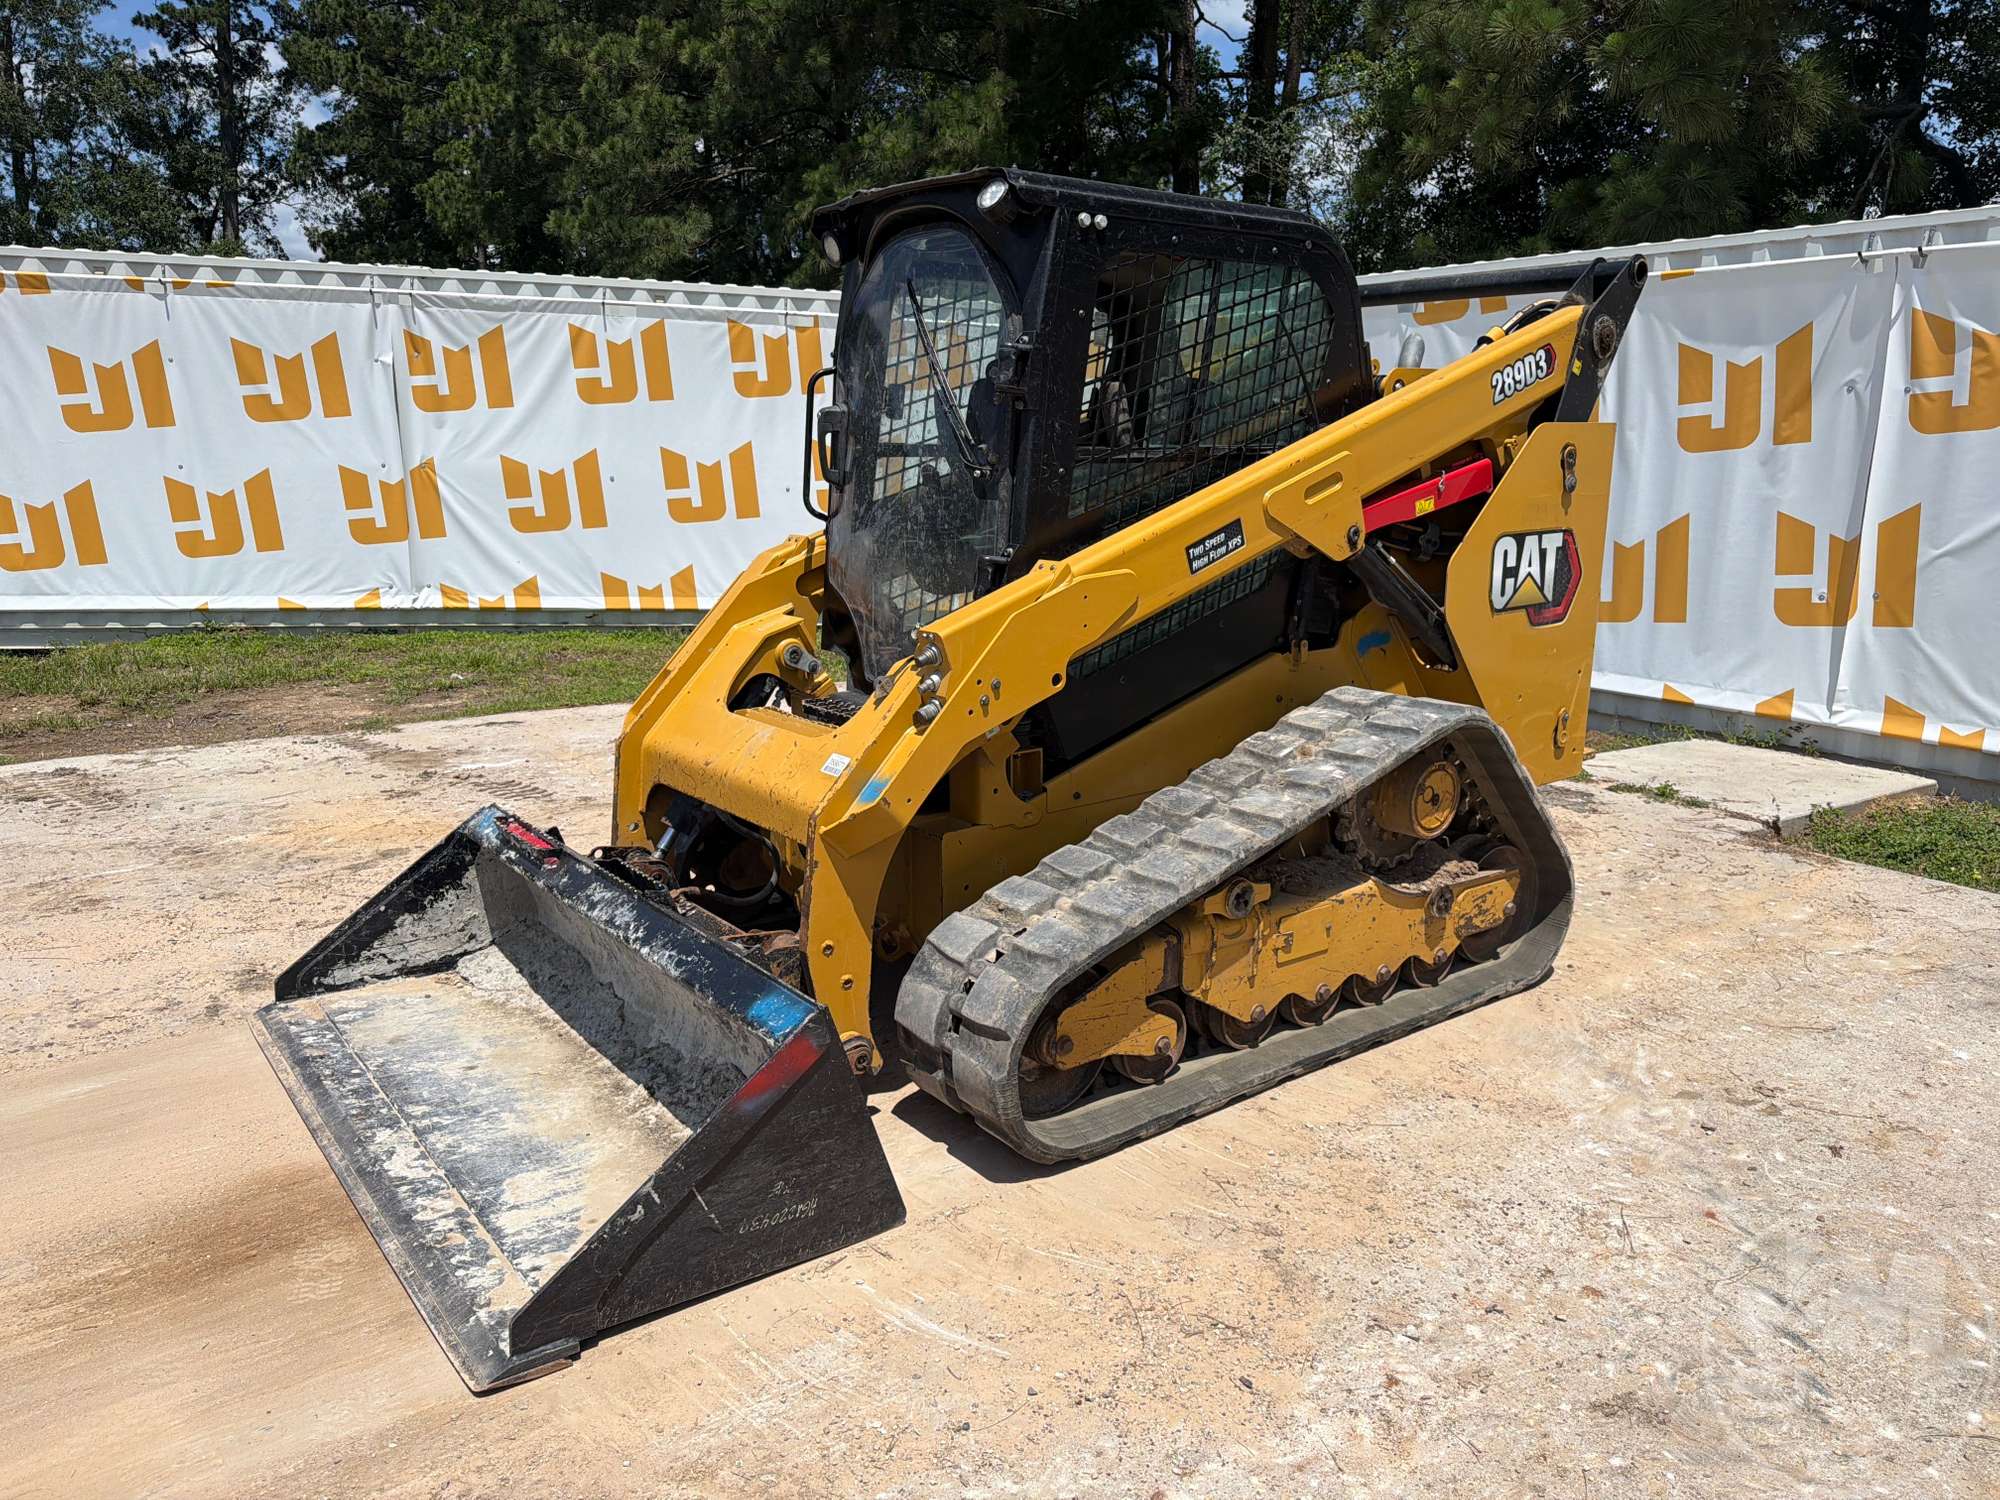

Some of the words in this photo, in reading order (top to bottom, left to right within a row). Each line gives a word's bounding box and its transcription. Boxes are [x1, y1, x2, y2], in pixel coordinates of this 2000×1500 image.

[1491, 348, 1547, 403] 289D3
[1228, 535, 1242, 551] XPS
[1491, 532, 1564, 609] CAT
